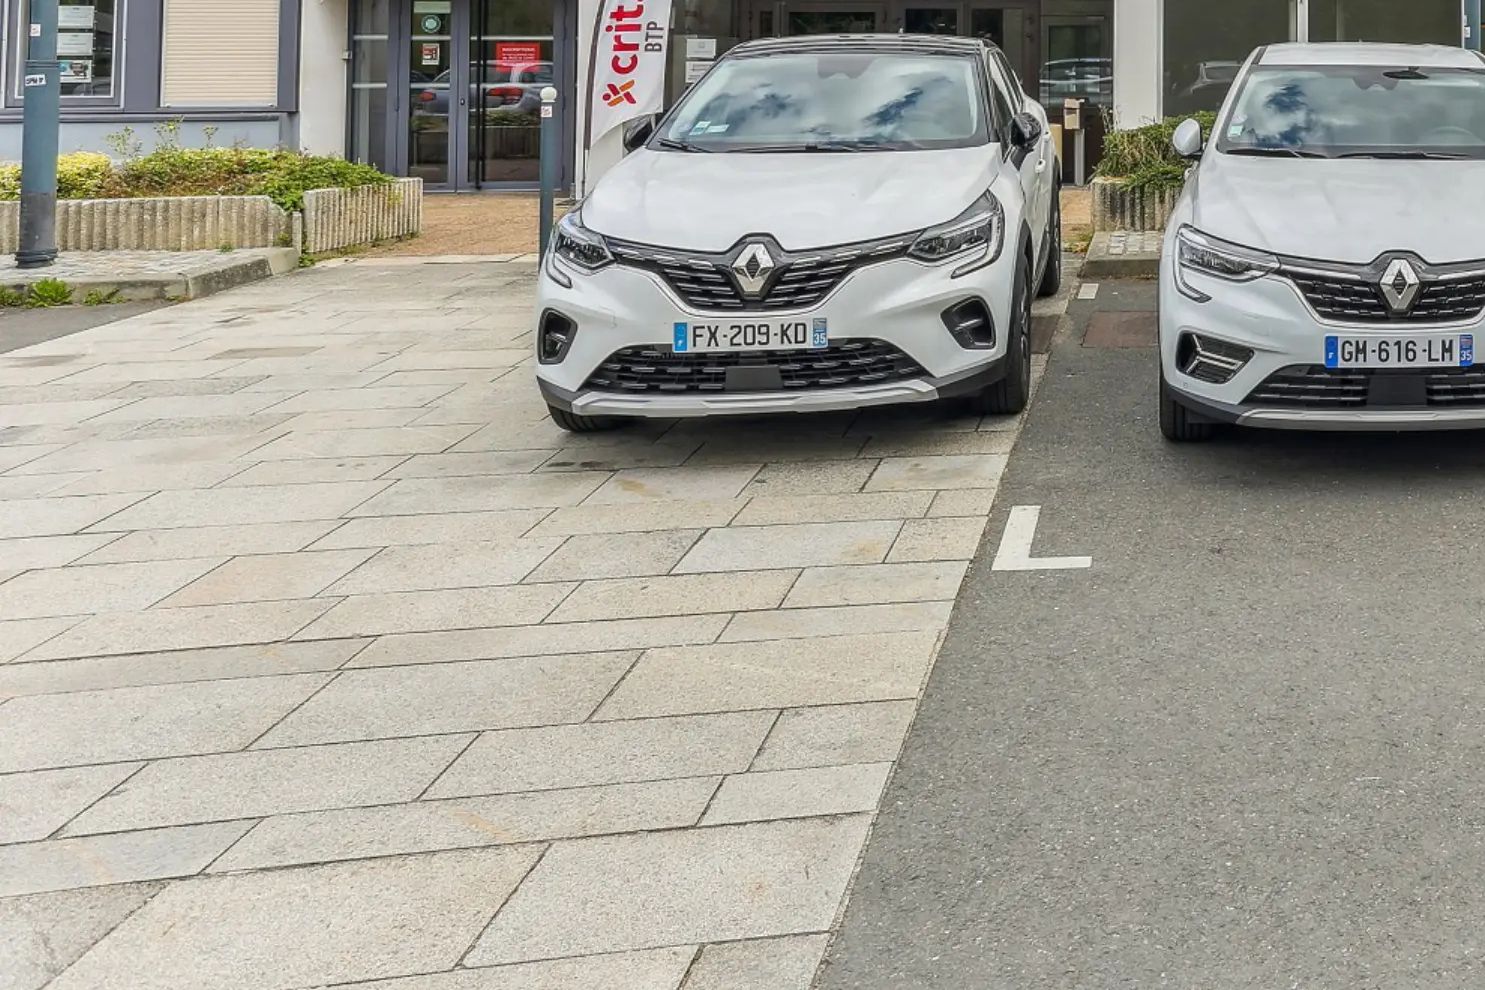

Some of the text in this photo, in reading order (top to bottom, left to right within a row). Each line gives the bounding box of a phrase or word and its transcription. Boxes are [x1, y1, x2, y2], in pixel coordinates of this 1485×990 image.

[645, 20, 664, 52] BTP
[692, 322, 807, 347] FX-209-KD
[813, 332, 826, 345] 35
[1341, 339, 1454, 363] GM-616-LM
[1460, 350, 1473, 361] 35
